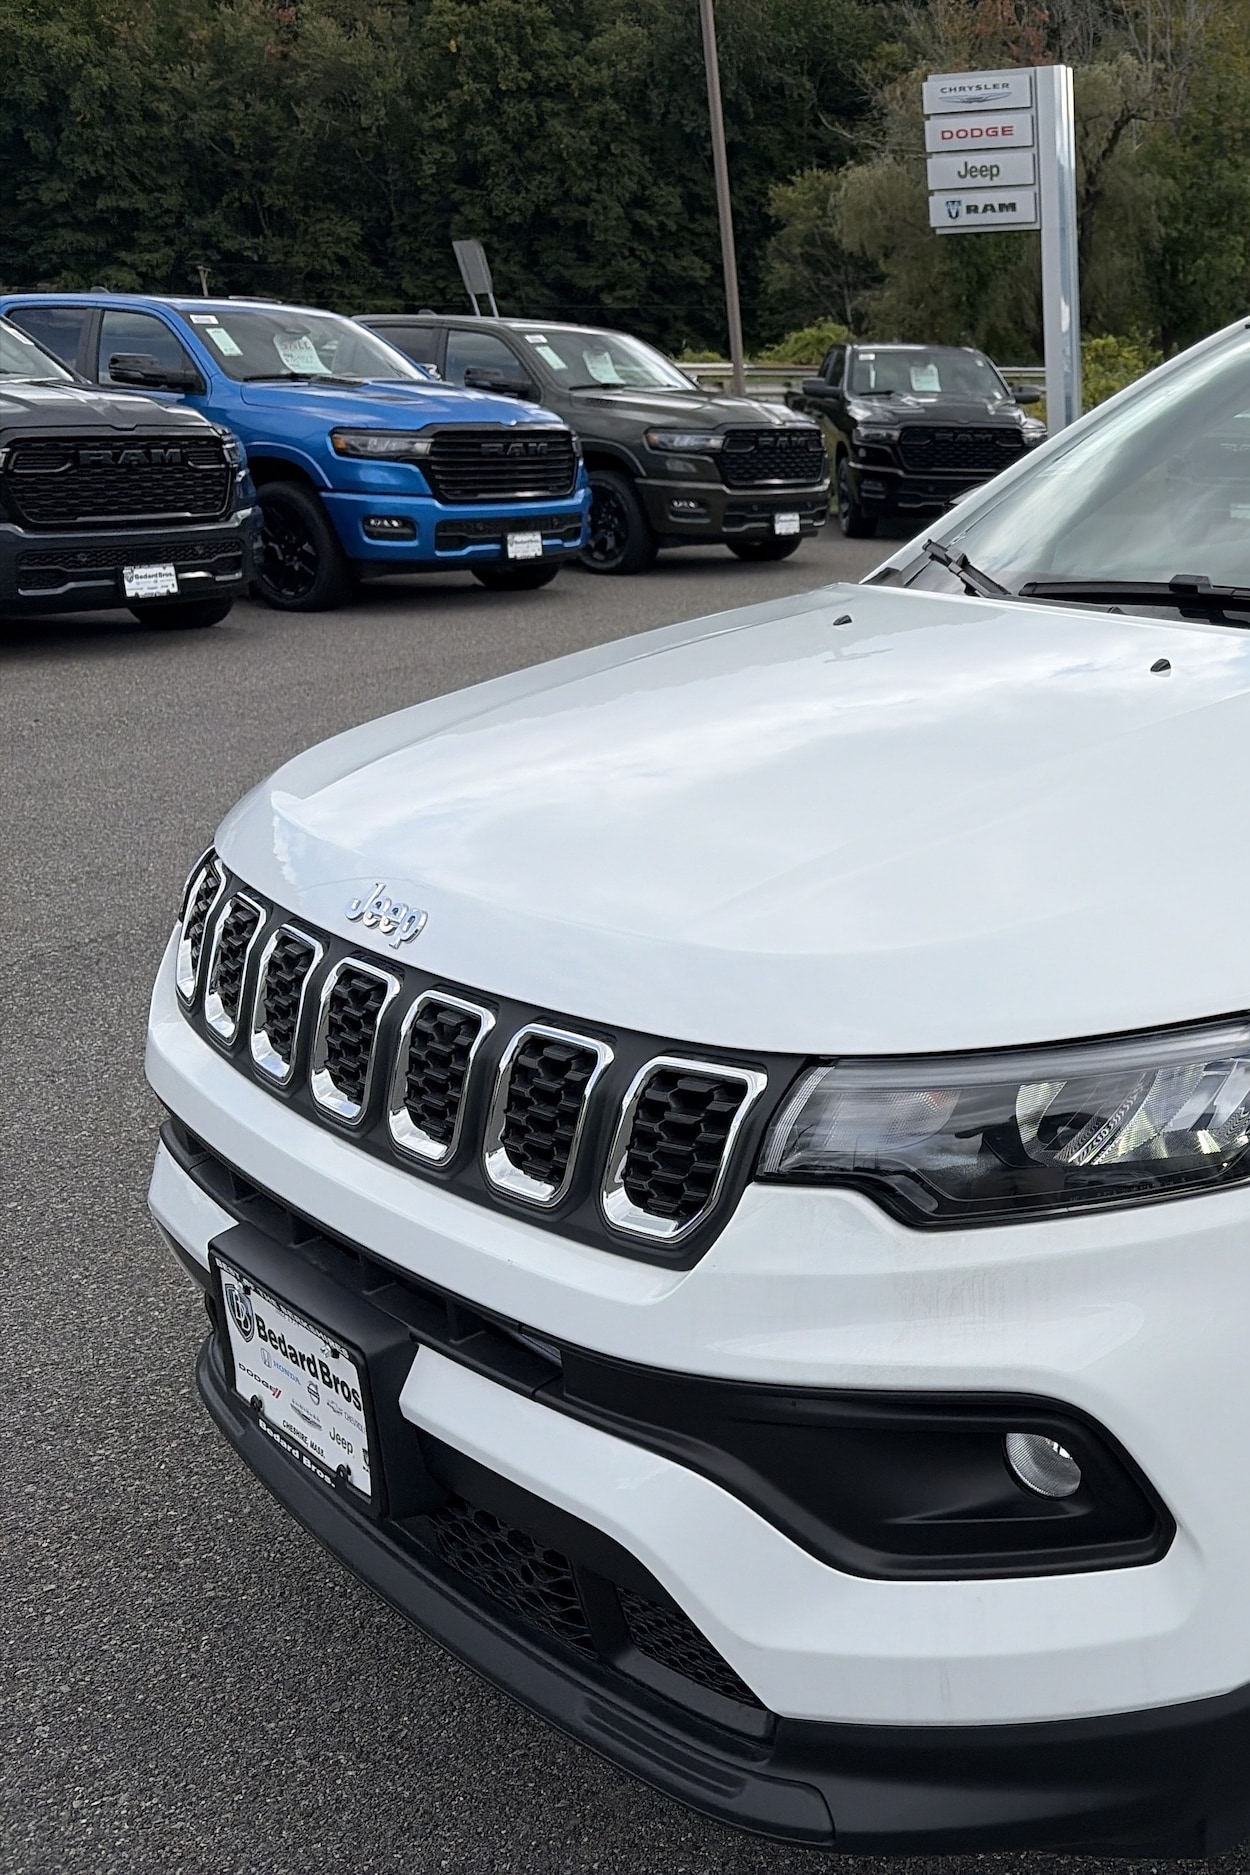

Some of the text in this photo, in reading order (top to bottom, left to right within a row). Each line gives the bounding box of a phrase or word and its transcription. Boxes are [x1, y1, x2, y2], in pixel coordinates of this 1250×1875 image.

[940, 82, 1010, 94] CHRYSLER
[941, 125, 1014, 141] DODGE
[957, 161, 1000, 181] Jeep
[966, 202, 1017, 215] RAM
[78, 448, 182, 466] RAM
[345, 882, 428, 950] Jeep
[214, 1256, 241, 1281] BEST
[254, 1313, 319, 1380] Bedard
[272, 1360, 302, 1386] HONDA
[258, 1418, 336, 1489] Bedard Bros.
[328, 1426, 354, 1456] Jeep
